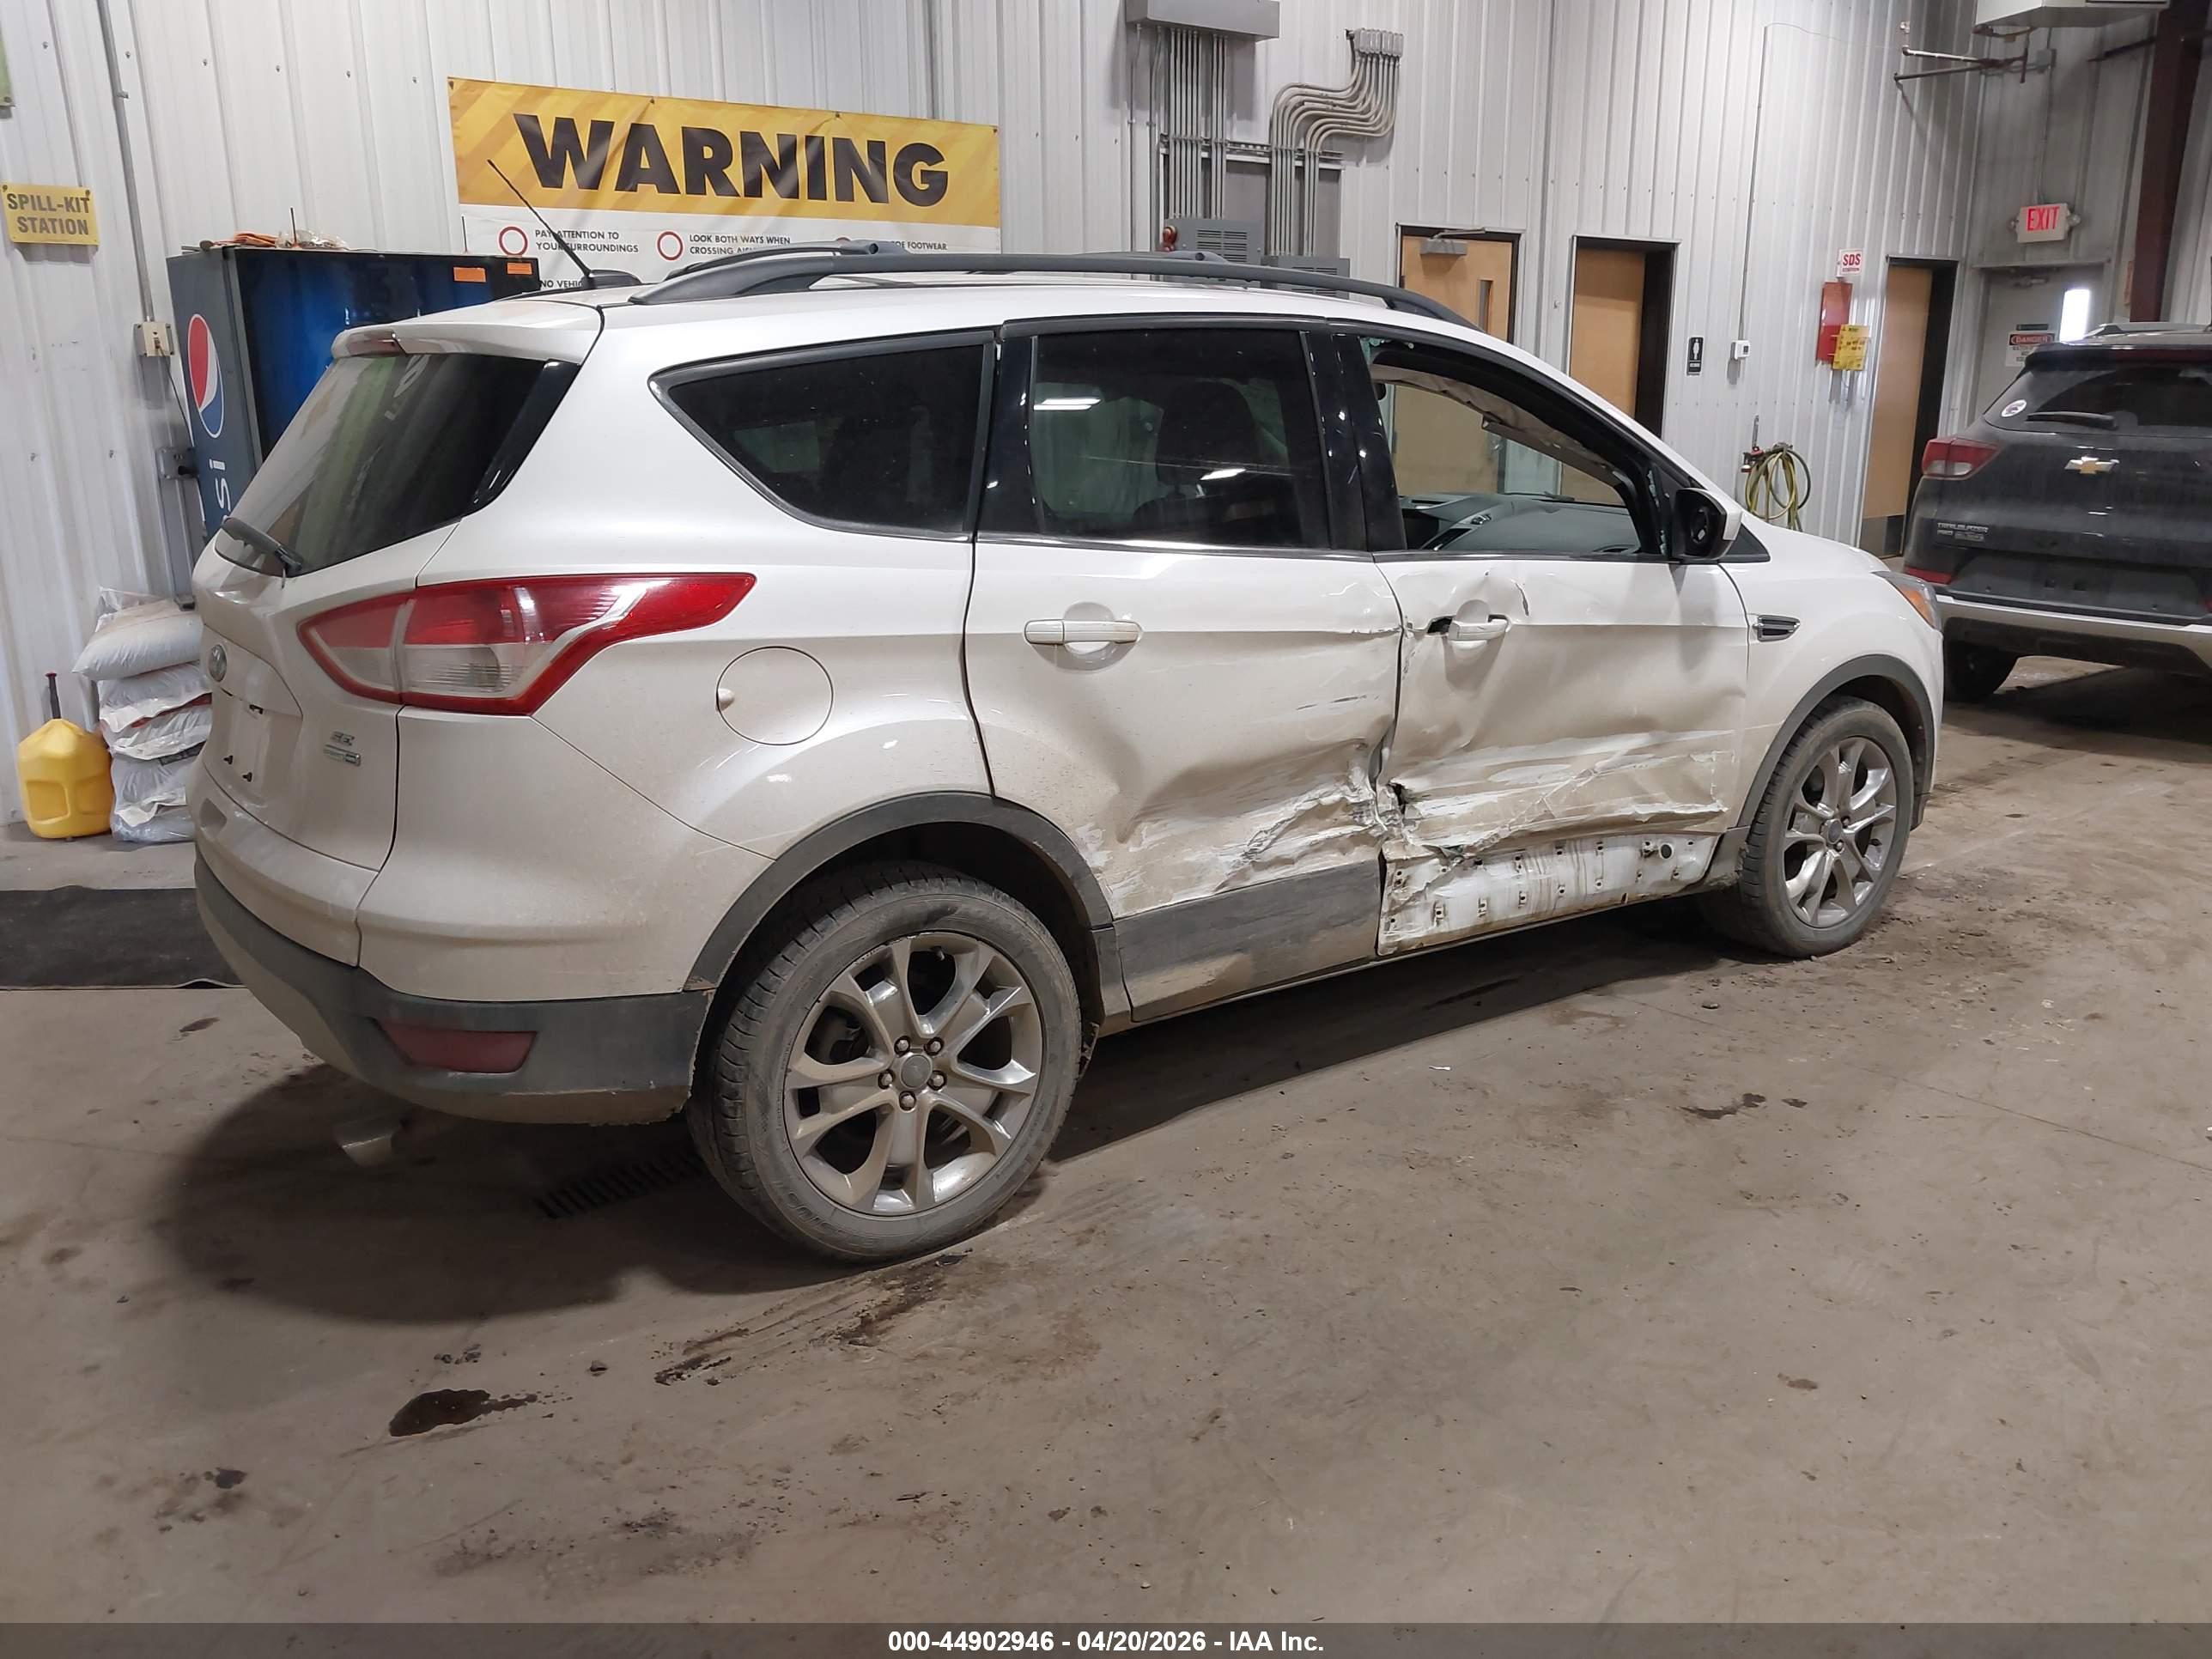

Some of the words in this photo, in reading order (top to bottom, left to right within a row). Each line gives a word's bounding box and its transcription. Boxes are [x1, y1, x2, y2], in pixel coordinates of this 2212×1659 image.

[513, 112, 949, 207] WARNING
[7, 193, 90, 214] SPILL-KIT
[2027, 206, 2060, 231] EXIT
[17, 216, 89, 235] STATION
[535, 229, 552, 238] PAY
[557, 230, 605, 240] ATTENTION
[608, 232, 619, 240] TO
[715, 235, 738, 244] BOTH
[690, 246, 734, 255] CROSSING
[907, 241, 948, 250] FOOTWEAR
[1843, 253, 1862, 266] SDS
[541, 280, 554, 289] NO
